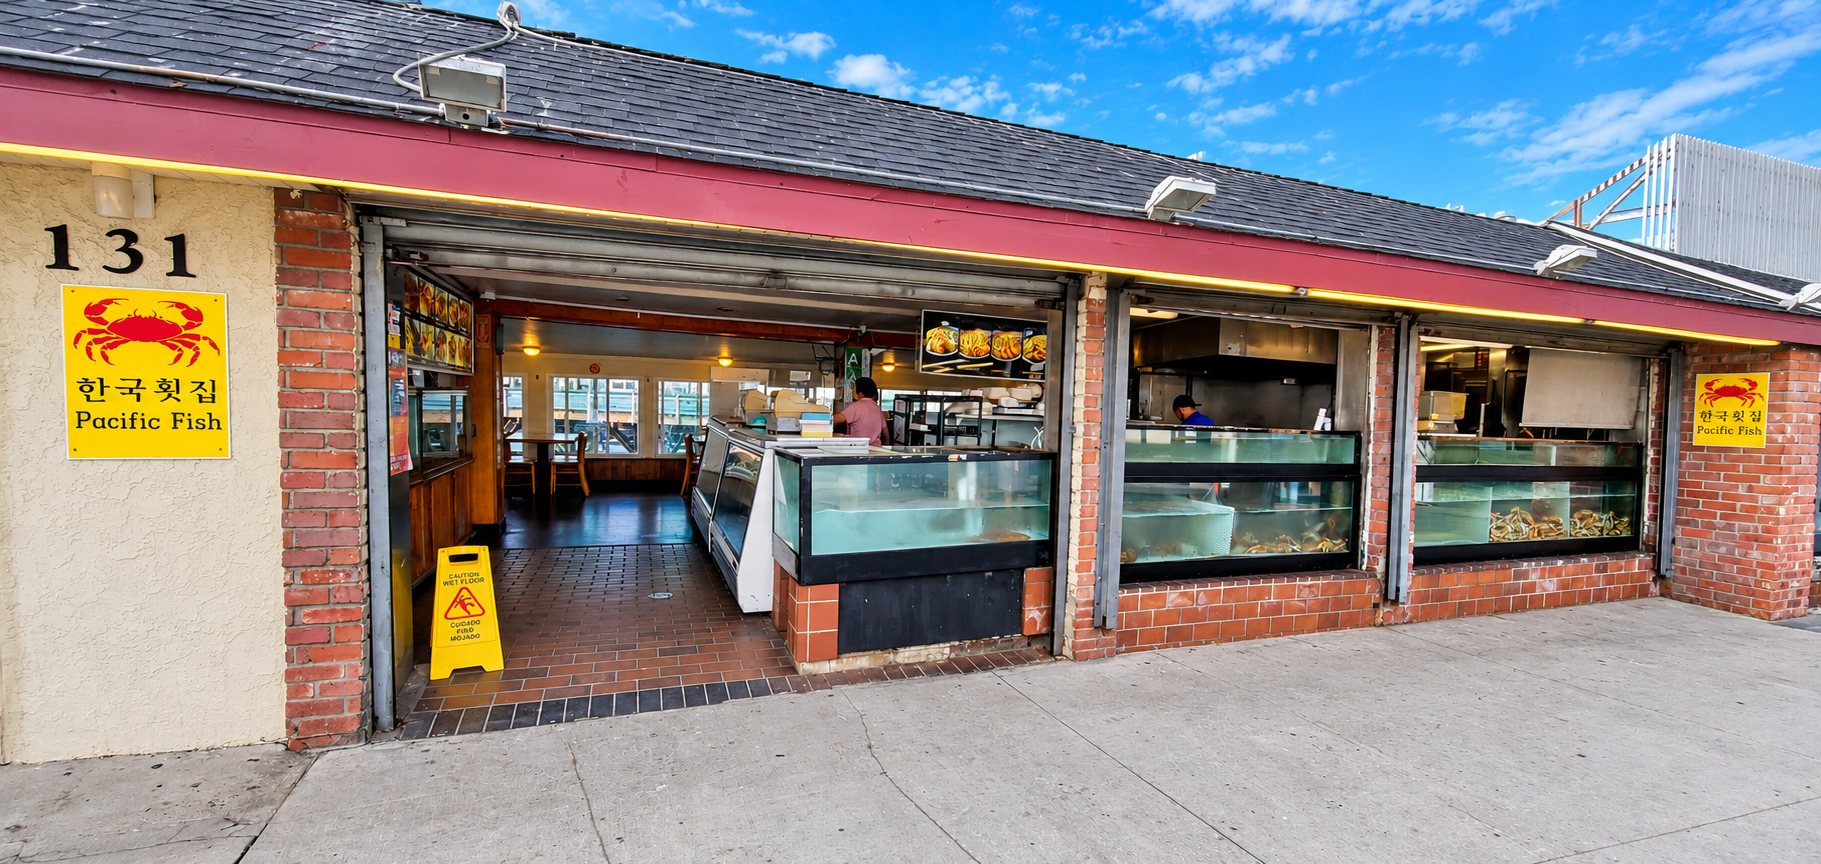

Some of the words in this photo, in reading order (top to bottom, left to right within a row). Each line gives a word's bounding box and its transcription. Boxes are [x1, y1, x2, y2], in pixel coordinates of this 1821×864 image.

[44, 224, 197, 279] 131
[76, 377, 217, 404] 한국횟집
[75, 411, 161, 430] Pacific
[171, 412, 222, 430] Fish
[1697, 425, 1734, 435] Pacific
[1738, 426, 1762, 436] Fish
[460, 577, 485, 585] FLOOR
[450, 633, 480, 641] MOJADO
